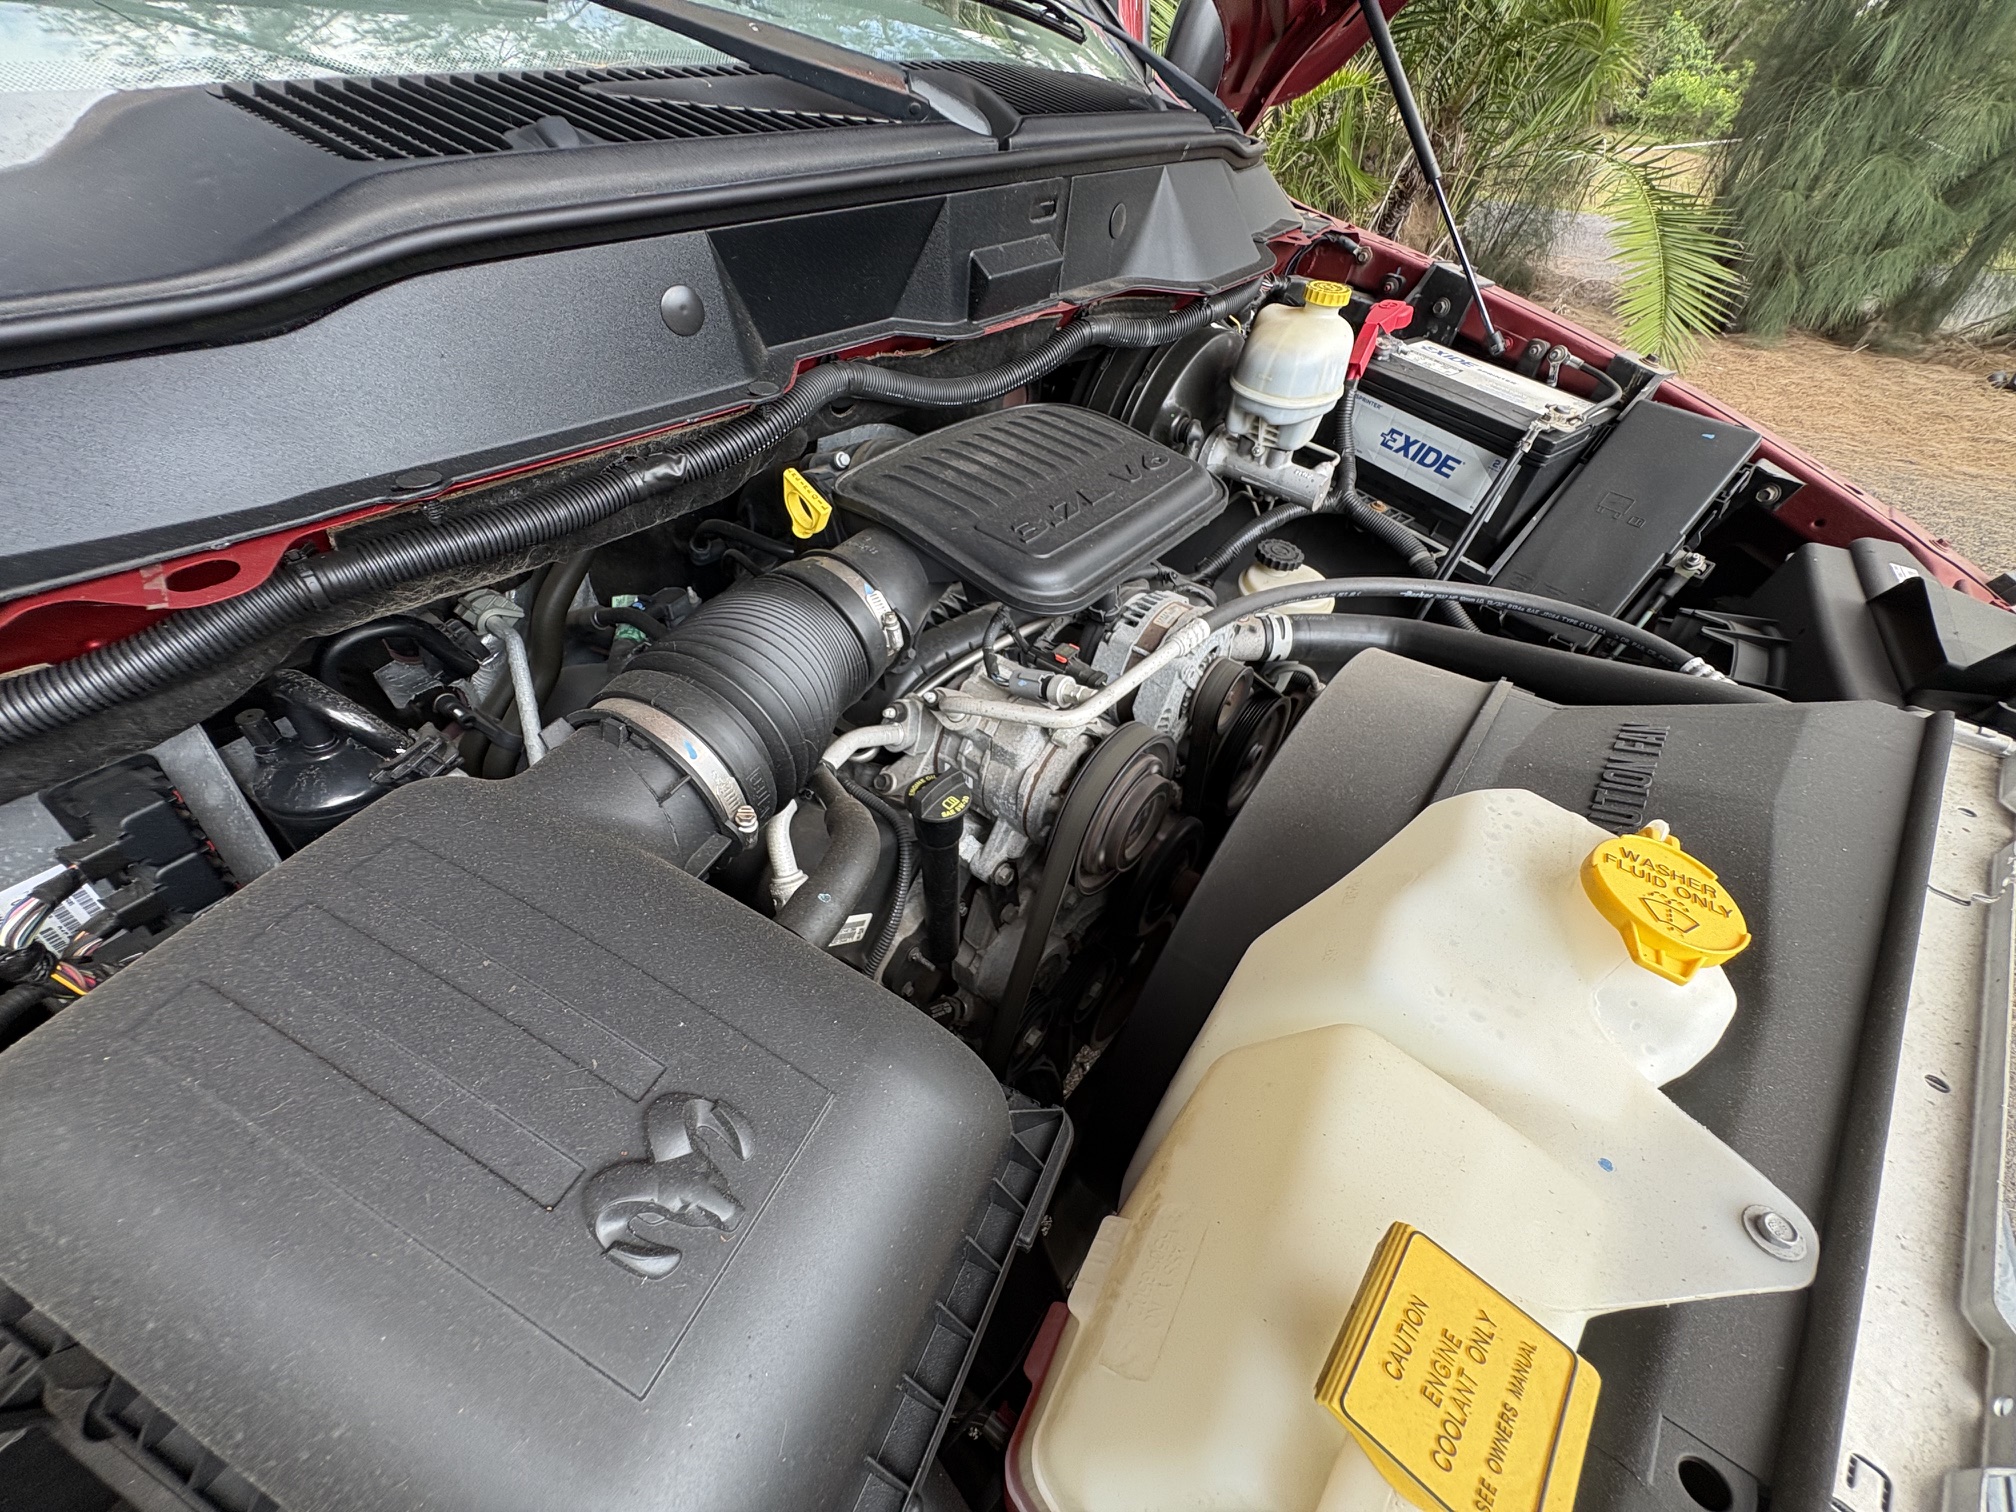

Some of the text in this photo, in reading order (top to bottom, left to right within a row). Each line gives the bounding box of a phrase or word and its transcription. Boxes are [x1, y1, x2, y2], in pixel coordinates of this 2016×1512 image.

[1420, 344, 1476, 368] EXIDE
[1354, 393, 1382, 410] SPRINTER
[1108, 450, 1171, 483] V6
[1380, 427, 1462, 479] EXIDE
[811, 493, 829, 511] OIL
[1561, 616, 1579, 625] TYPE
[1586, 722, 1671, 828] UTION FAN
[941, 808, 956, 818] SAE
[1603, 852, 1734, 919] FLUID ONLY
[1619, 846, 1717, 899] WASHER
[1381, 1294, 1431, 1381] CAUTION
[1420, 1327, 1464, 1409] ENGINE
[1430, 1308, 1499, 1473] COOLANT ONLY
[1474, 1339, 1538, 1512] SEE OWNERS MANUAL
